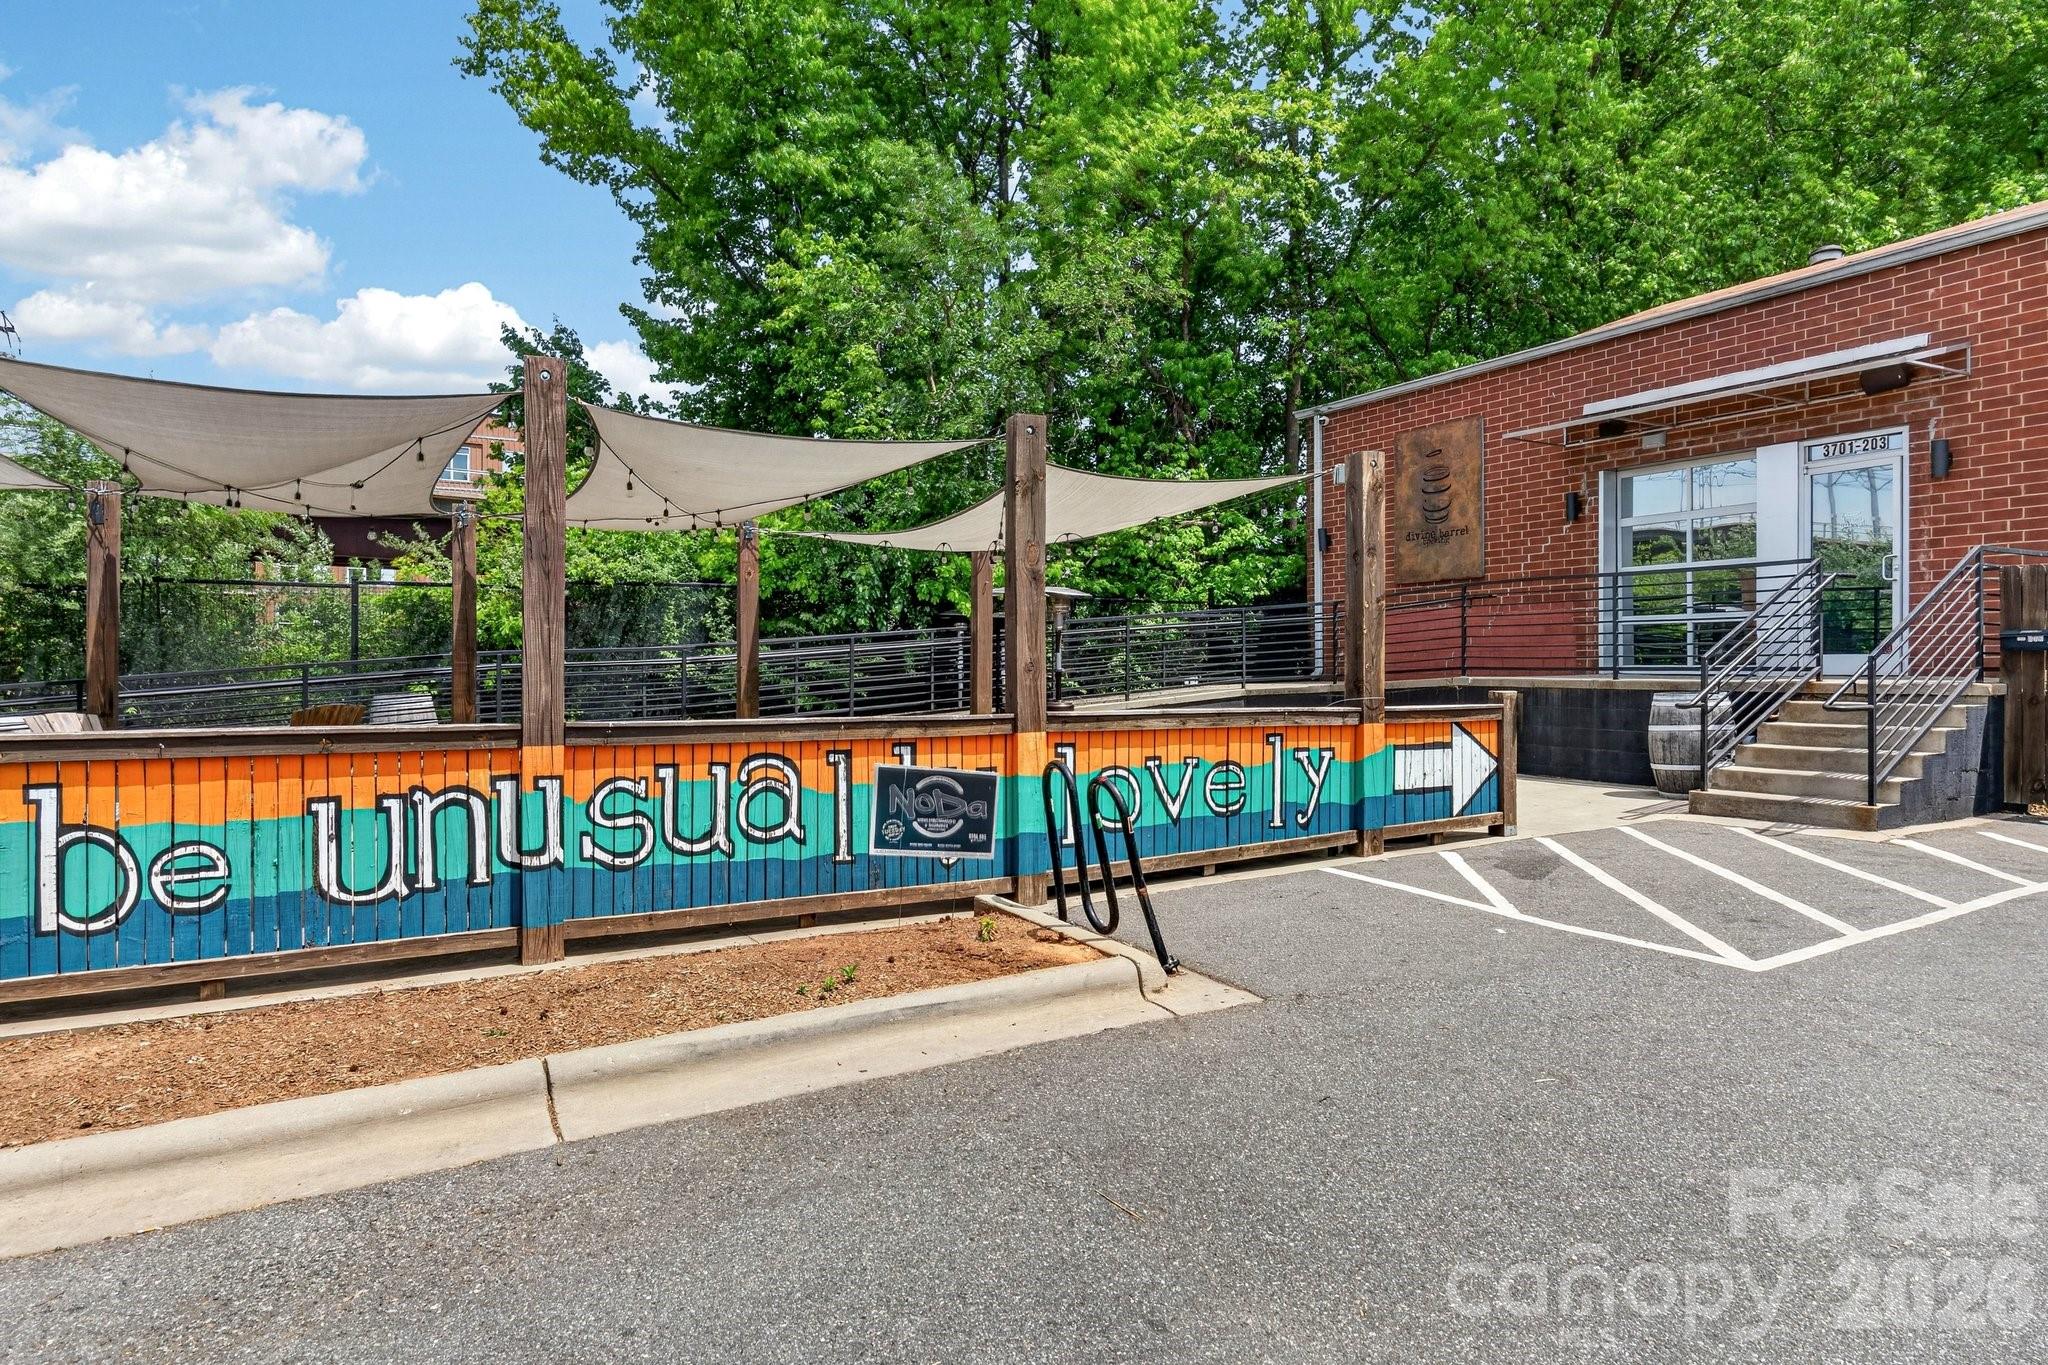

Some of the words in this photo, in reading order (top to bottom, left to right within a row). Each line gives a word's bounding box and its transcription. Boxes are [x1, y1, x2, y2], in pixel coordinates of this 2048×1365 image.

[1822, 437, 1888, 458] 3701-203
[1439, 525, 1470, 538] barrel
[888, 784, 988, 820] NoDa
[23, 783, 232, 937] be
[307, 741, 998, 906] unusual
[1053, 733, 1335, 849] lovely
